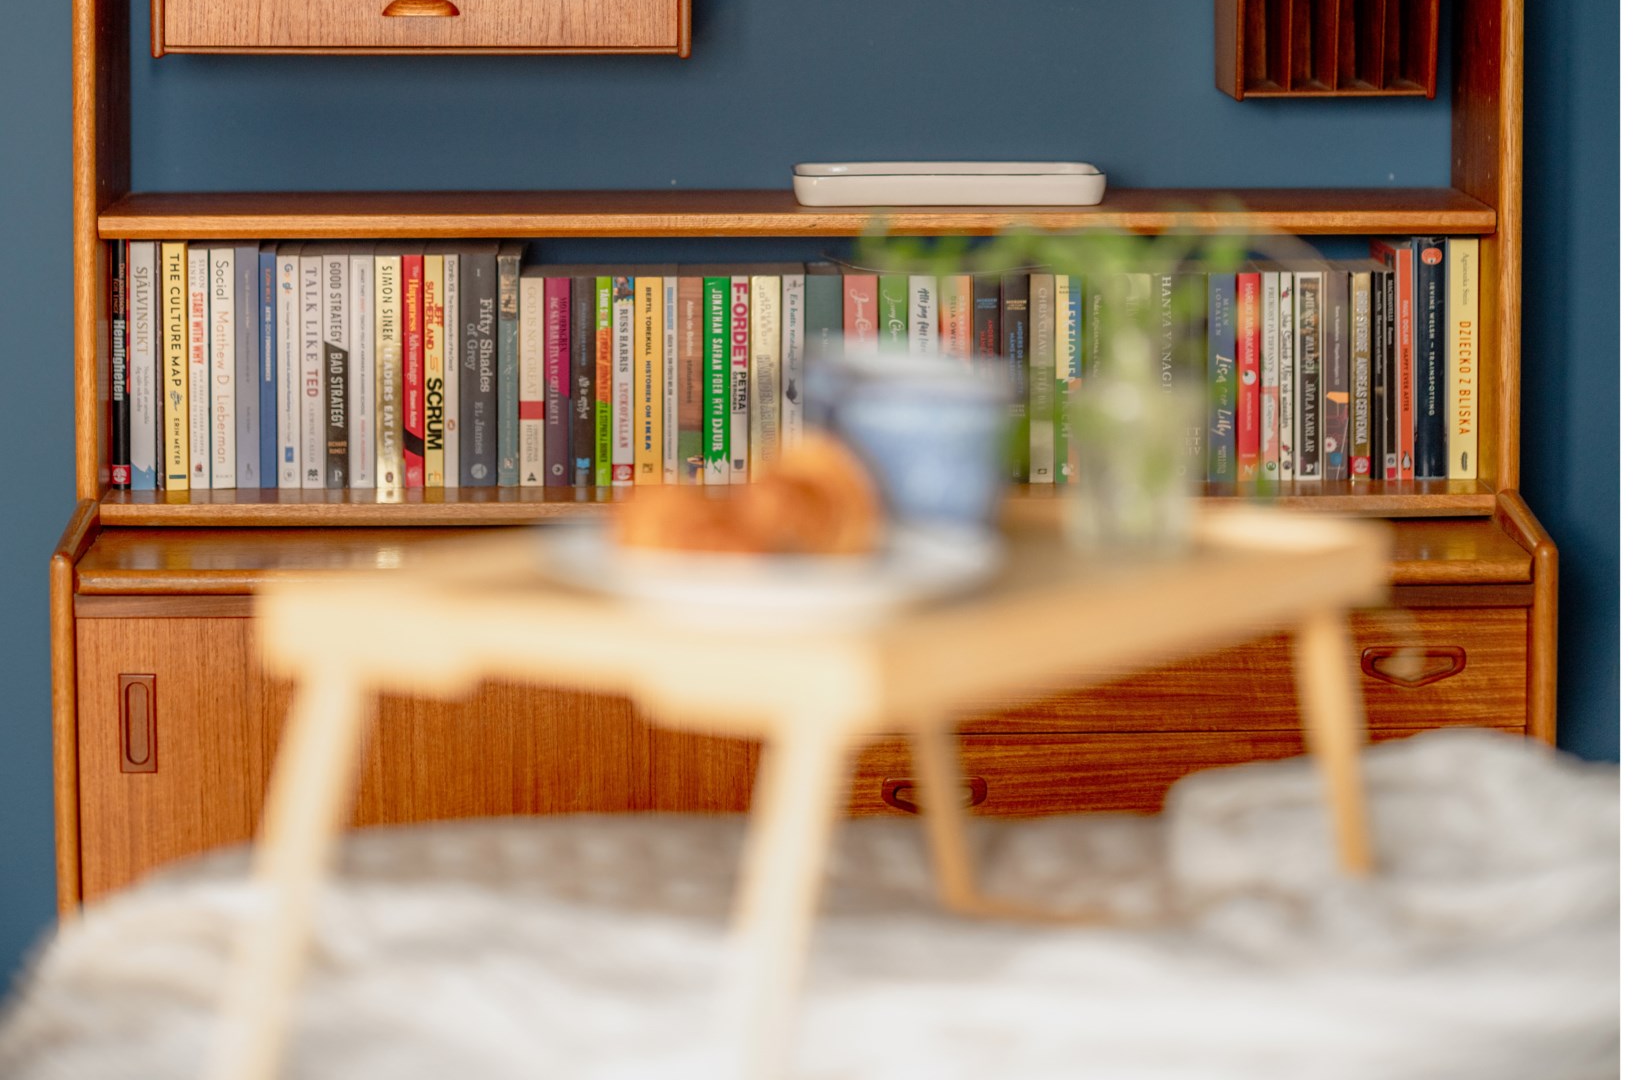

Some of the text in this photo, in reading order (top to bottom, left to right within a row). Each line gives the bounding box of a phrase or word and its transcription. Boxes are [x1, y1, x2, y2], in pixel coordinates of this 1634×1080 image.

[170, 254, 180, 281] THE
[216, 261, 229, 300] Social
[134, 266, 150, 356] SJÄLVINSIKT
[170, 287, 181, 350] CULTURE
[192, 292, 204, 364] START WITH WHY
[426, 281, 434, 350] SUTHERLAND
[619, 309, 628, 333] RUSS
[733, 282, 748, 367] F-ORDET
[1161, 276, 1171, 327] HANYA
[112, 320, 125, 401] Hemligheten
[216, 311, 228, 369] Matthew
[305, 267, 318, 397] TALK LIKE TED
[330, 262, 343, 428] GOOD STRATEGY BAD STRATEGY
[382, 265, 394, 428] SIMON SINEK LEADERS EAT
[464, 339, 477, 370] Grey
[479, 298, 493, 392] Fifty Shades
[527, 287, 537, 396] GOD IS NOT GREAT
[619, 335, 629, 372] HARRIS
[1459, 321, 1471, 373] DZIECKO
[171, 356, 181, 387] MAP
[712, 288, 723, 451] JONATHAN SAFRAN FOER DJUR
[738, 372, 746, 410] PETRA
[1215, 354, 1232, 383] Lisa
[217, 395, 230, 464] Lieberman
[427, 378, 442, 450] SCRUM
[474, 419, 486, 454] James
[646, 405, 652, 418] OM
[1305, 413, 1315, 452] KARLAR
[1459, 389, 1471, 435] BLISKA
